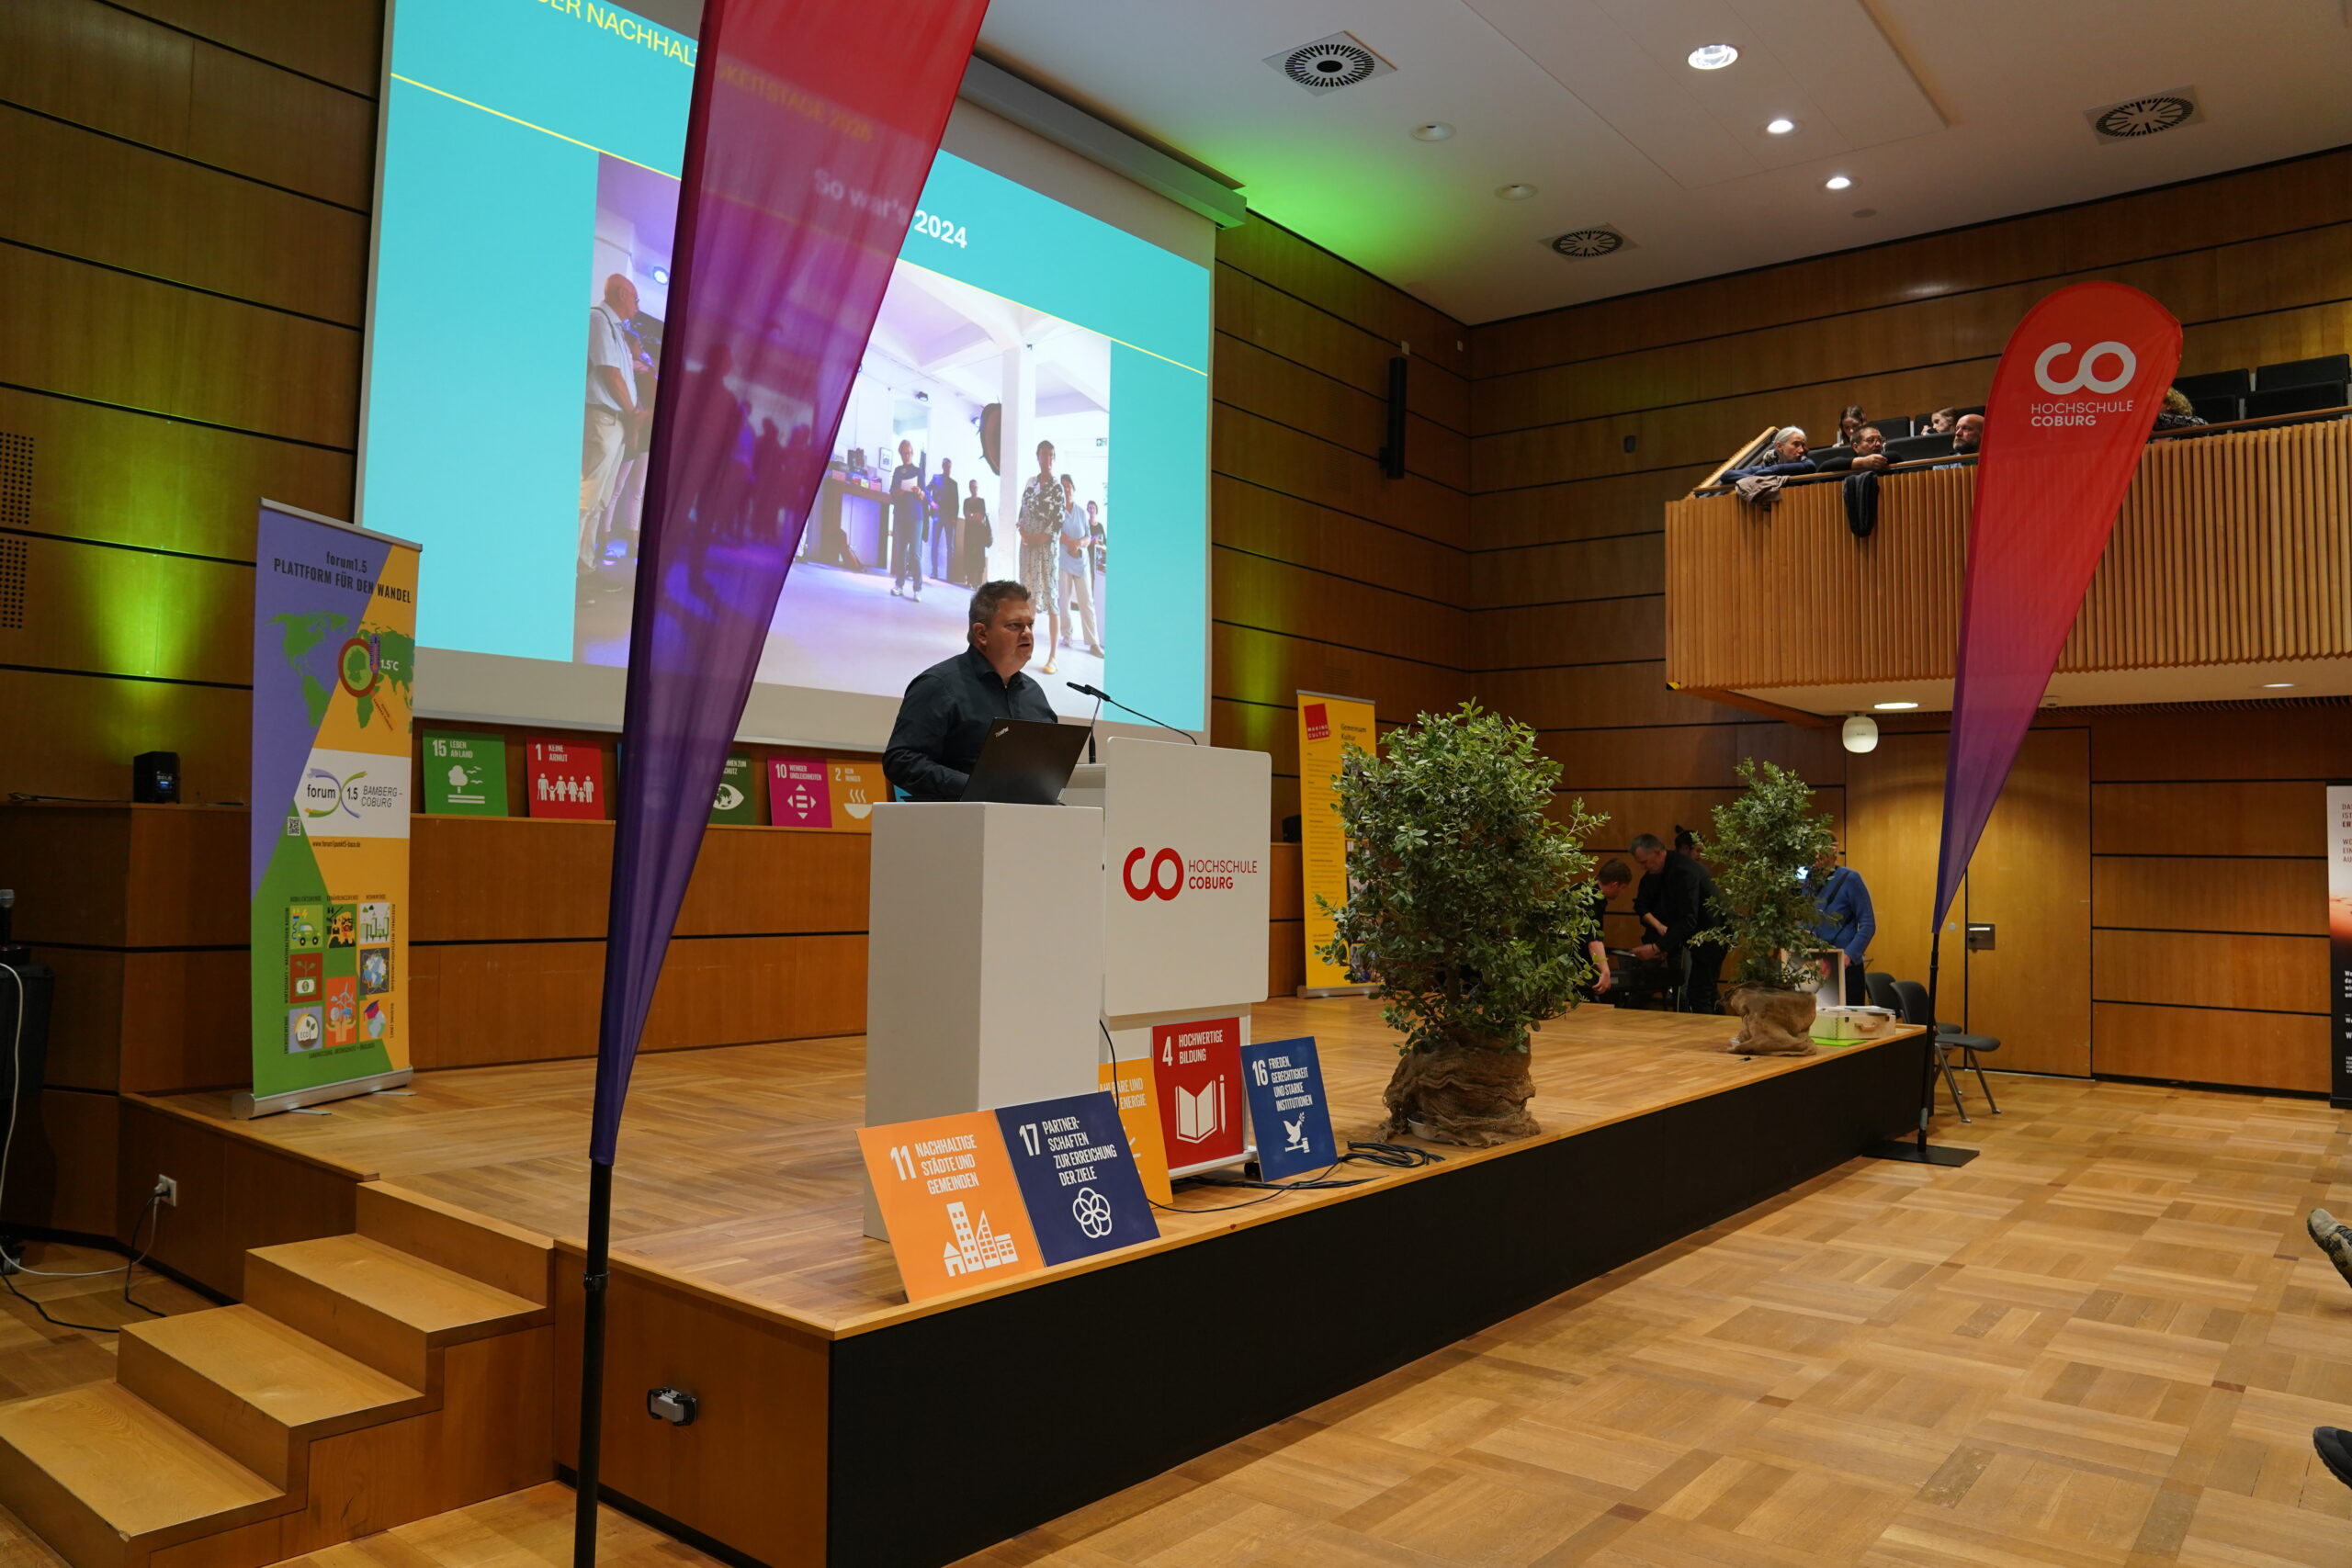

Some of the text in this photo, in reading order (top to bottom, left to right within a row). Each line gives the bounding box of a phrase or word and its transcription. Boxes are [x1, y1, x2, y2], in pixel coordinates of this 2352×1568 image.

[914, 209, 967, 249] 2024
[2031, 400, 2134, 414] HOCHSCHULE
[2031, 415, 2097, 427] COBURG
[326, 551, 367, 573] forum1.5
[274, 558, 411, 604] PLATTFORM FÜR DEN WANDEL
[433, 739, 447, 757] 15
[450, 740, 467, 749] LEBEN
[536, 743, 542, 761] 1
[548, 744, 564, 752] KEINE
[548, 753, 568, 761] ARMUT
[775, 764, 786, 778] 10
[835, 767, 842, 781] 2
[307, 784, 335, 799] forum
[347, 787, 357, 800] 1.5
[363, 785, 397, 797] BAMBERG
[361, 797, 392, 808] COBURG
[1189, 860, 1257, 873] HOCHSCHULE
[1189, 876, 1234, 889] COBURG
[1179, 1030, 1224, 1048] HOCHWERTIGE
[1162, 1036, 1173, 1066] 4
[1179, 1048, 1206, 1065] BILDUNG
[1268, 1055, 1292, 1070] FRIEDEN,
[1252, 1059, 1269, 1087] 16
[1271, 1066, 1309, 1084] GERECHTIGKEIT
[1129, 1077, 1144, 1091] UND
[1273, 1082, 1305, 1098] UND STARKE
[1119, 1093, 1148, 1111] ENERGIE
[1276, 1094, 1313, 1112] INSTITUTIONEN
[1042, 1116, 1080, 1134] PARTNER-
[914, 1134, 978, 1157] NACHHALTIGE
[1019, 1123, 1041, 1156] 17
[1047, 1132, 1090, 1152] SCHAFTEN
[890, 1145, 917, 1181] 11
[921, 1154, 976, 1176] STÄDTE UND
[1053, 1145, 1117, 1169] ZUR ERREICHUNG
[926, 1172, 980, 1195] GEMEINDEN
[1058, 1166, 1097, 1187] DER ZIELE
